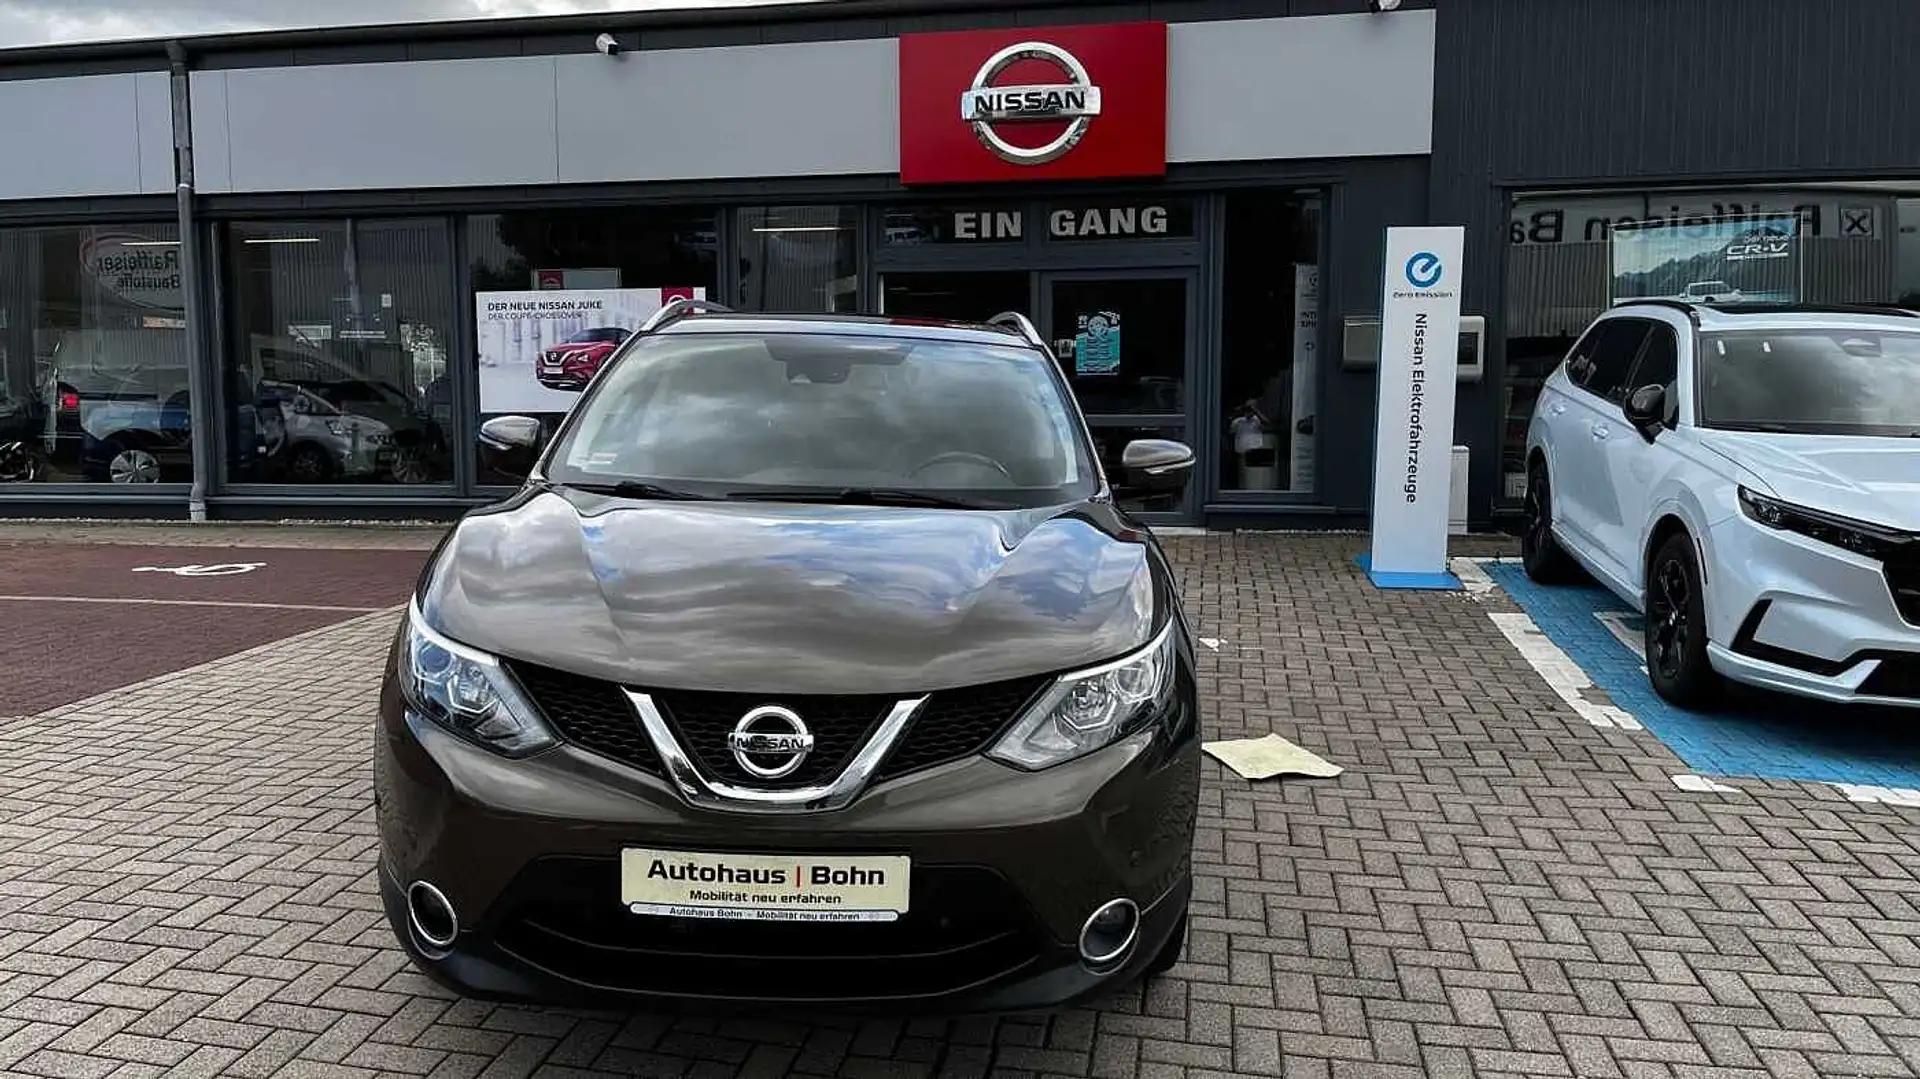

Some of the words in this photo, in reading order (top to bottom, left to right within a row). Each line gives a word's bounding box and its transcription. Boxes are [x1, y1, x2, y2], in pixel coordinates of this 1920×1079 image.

[974, 90, 1086, 112] NISSAN
[954, 211, 1022, 239] EIN
[1051, 206, 1168, 236] GANG
[488, 302, 508, 312] DER
[510, 301, 537, 311] NEUE
[539, 301, 575, 310] NISSAN
[577, 300, 603, 310] JUKE
[1413, 313, 1427, 366] Nissan
[1405, 369, 1424, 503] Elektrofahrzeuge
[736, 737, 804, 749] NISSAN
[647, 859, 786, 884] Autohaus
[811, 866, 885, 885] Bohn
[689, 890, 749, 903] Mobilität
[752, 894, 777, 903] neu
[780, 891, 842, 904] erfahren
[669, 906, 716, 918] Autohaus
[717, 908, 743, 919] Bohn
[818, 911, 860, 921] erfahren
